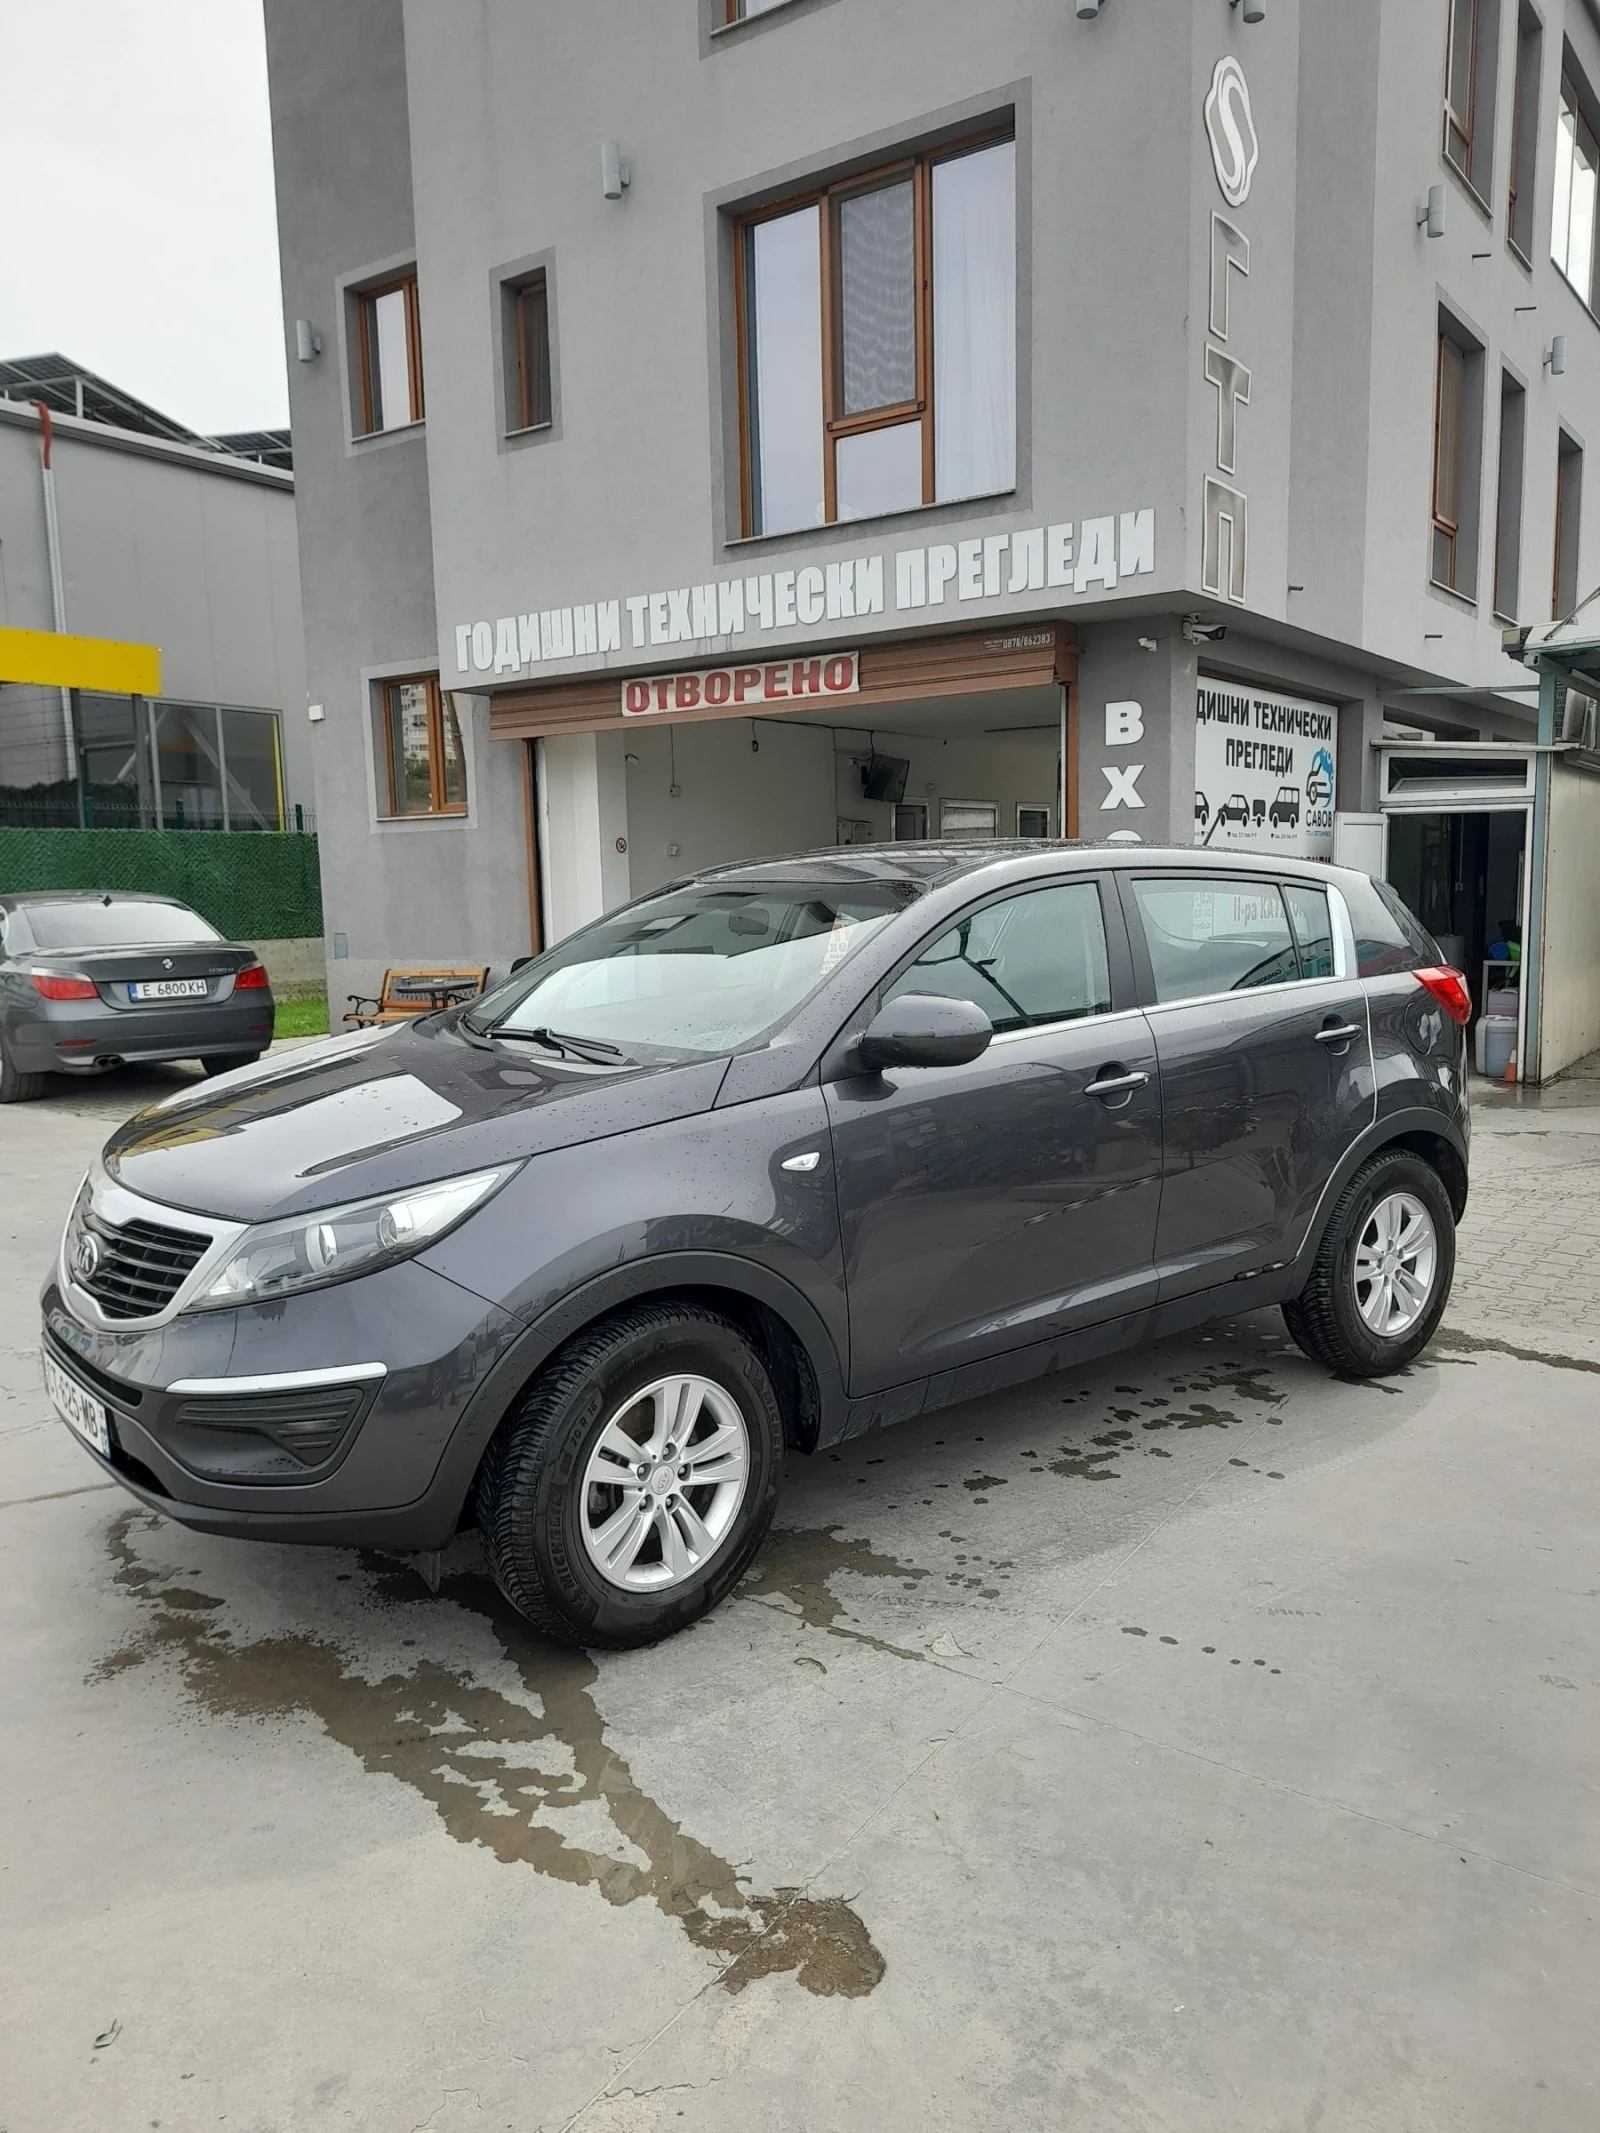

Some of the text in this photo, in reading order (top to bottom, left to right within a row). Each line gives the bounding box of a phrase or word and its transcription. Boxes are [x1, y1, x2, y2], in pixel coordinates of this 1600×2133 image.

[455, 508, 1155, 674] ГОДИШНИ ТЕХНИЧЕСКИ ПРЕГЛЕДИ
[626, 656, 854, 713] ОТВОРЕНО
[1254, 701, 1332, 741] ТЕХНИЧЕСКИ
[1100, 699, 1146, 841] ВХ
[1226, 738, 1293, 777] ПРЕГЛЕДИ
[1305, 808, 1332, 828] САВОВ
